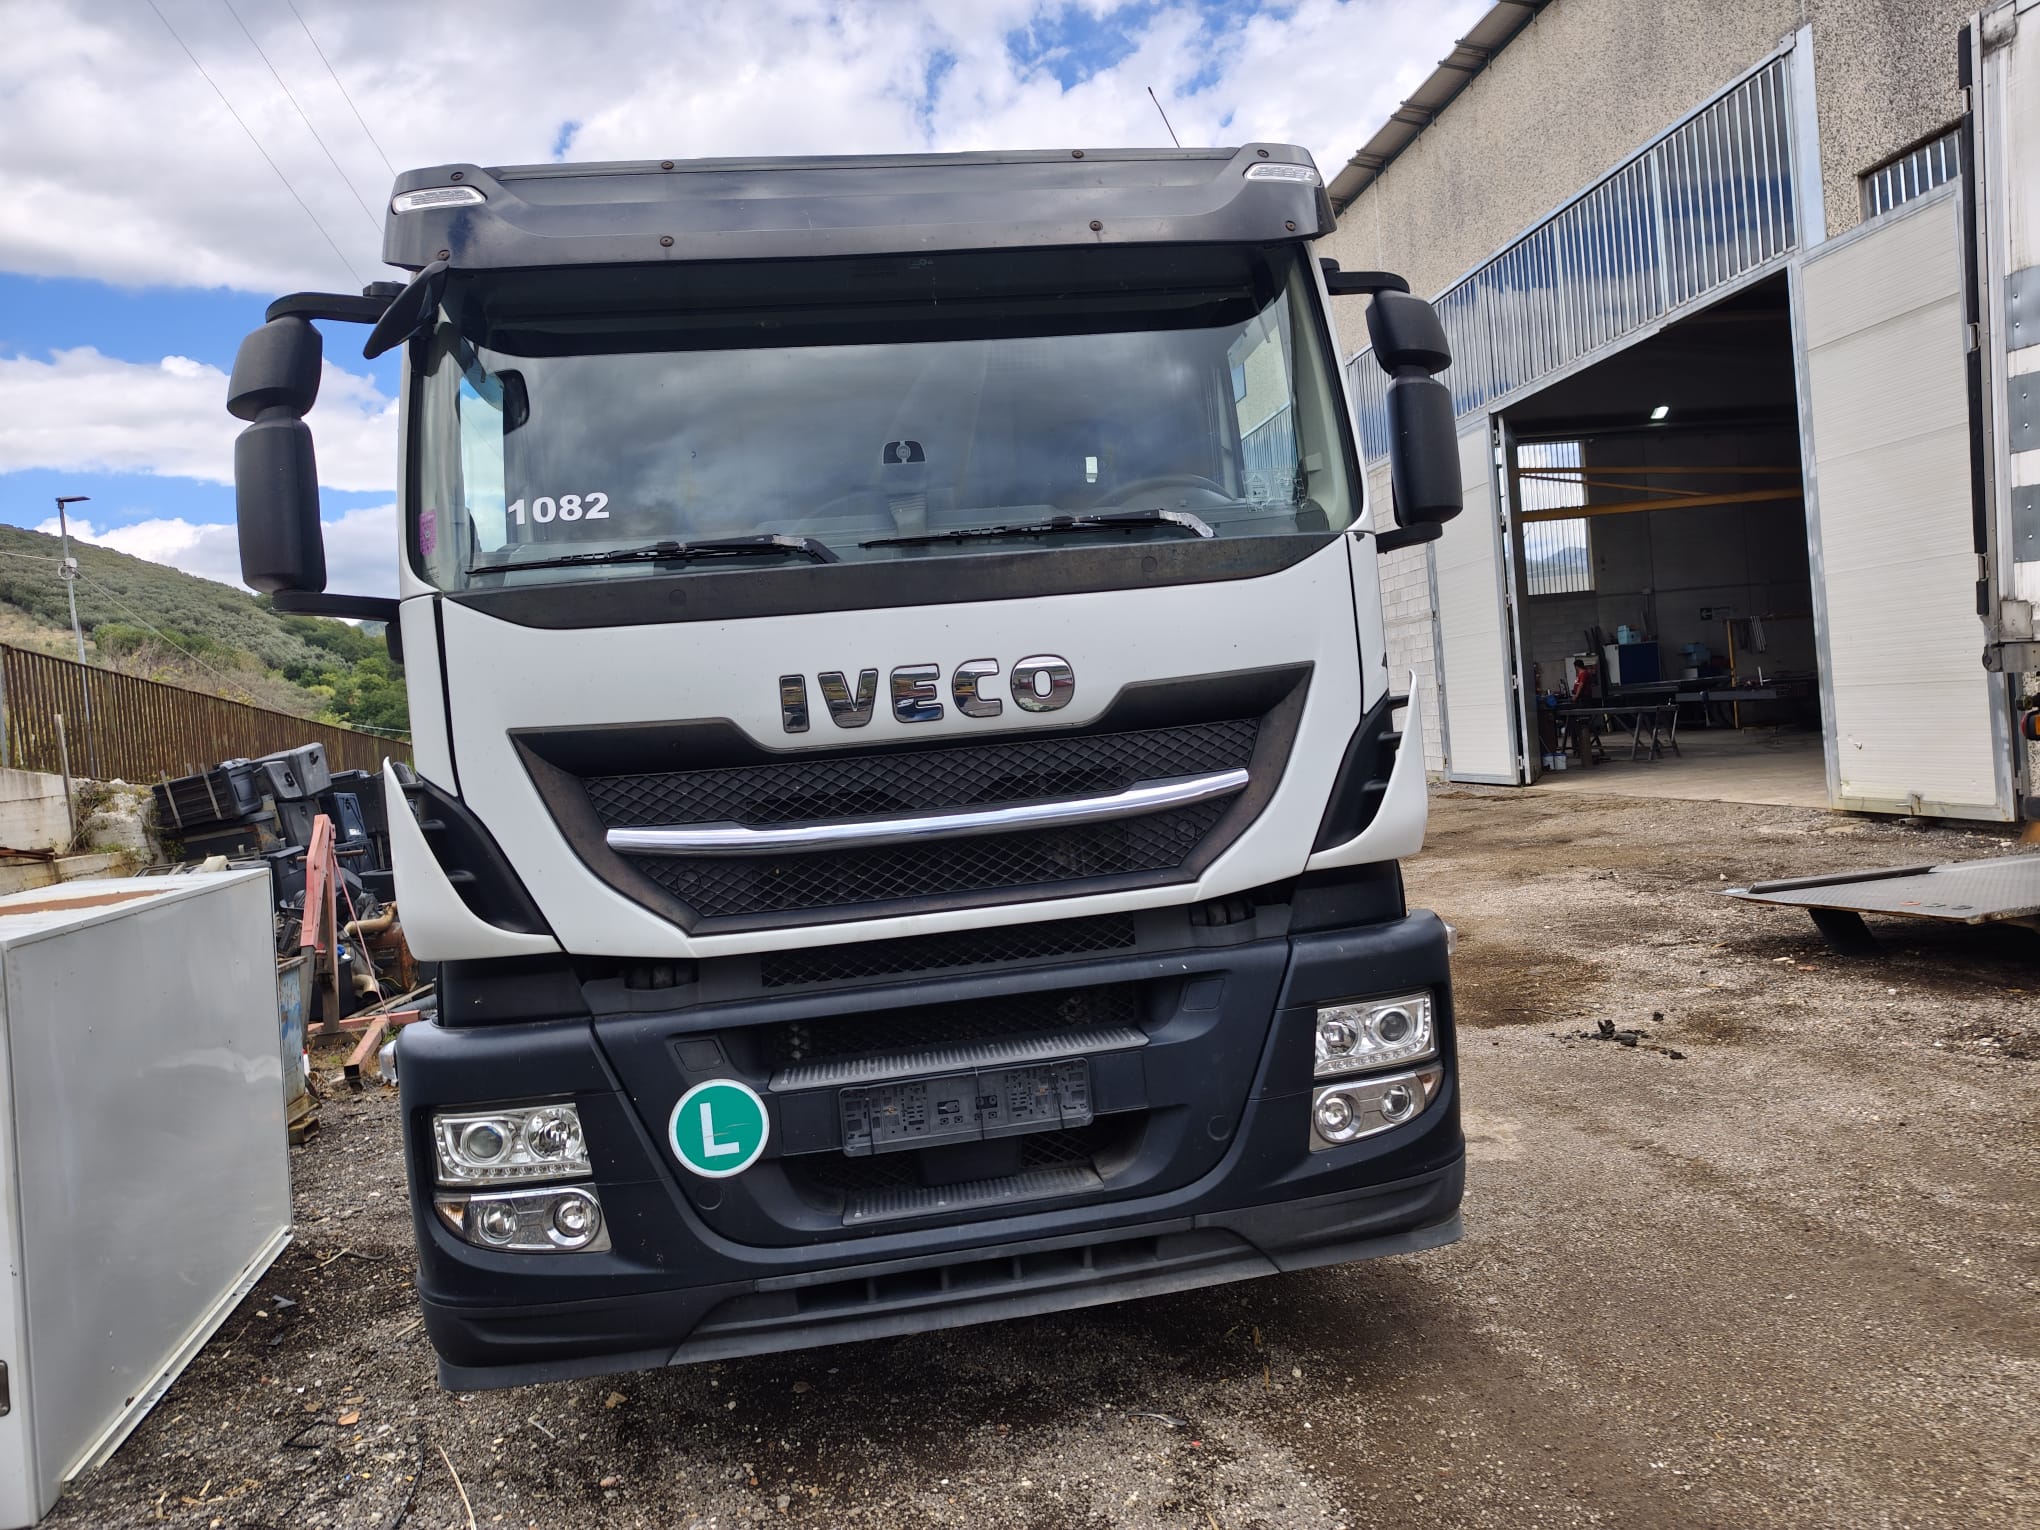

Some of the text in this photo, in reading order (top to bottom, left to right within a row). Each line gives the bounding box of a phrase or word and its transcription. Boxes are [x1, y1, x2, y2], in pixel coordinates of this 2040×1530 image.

[507, 492, 610, 525] 1082
[778, 653, 1076, 734] IVECO
[699, 1101, 740, 1158] L
